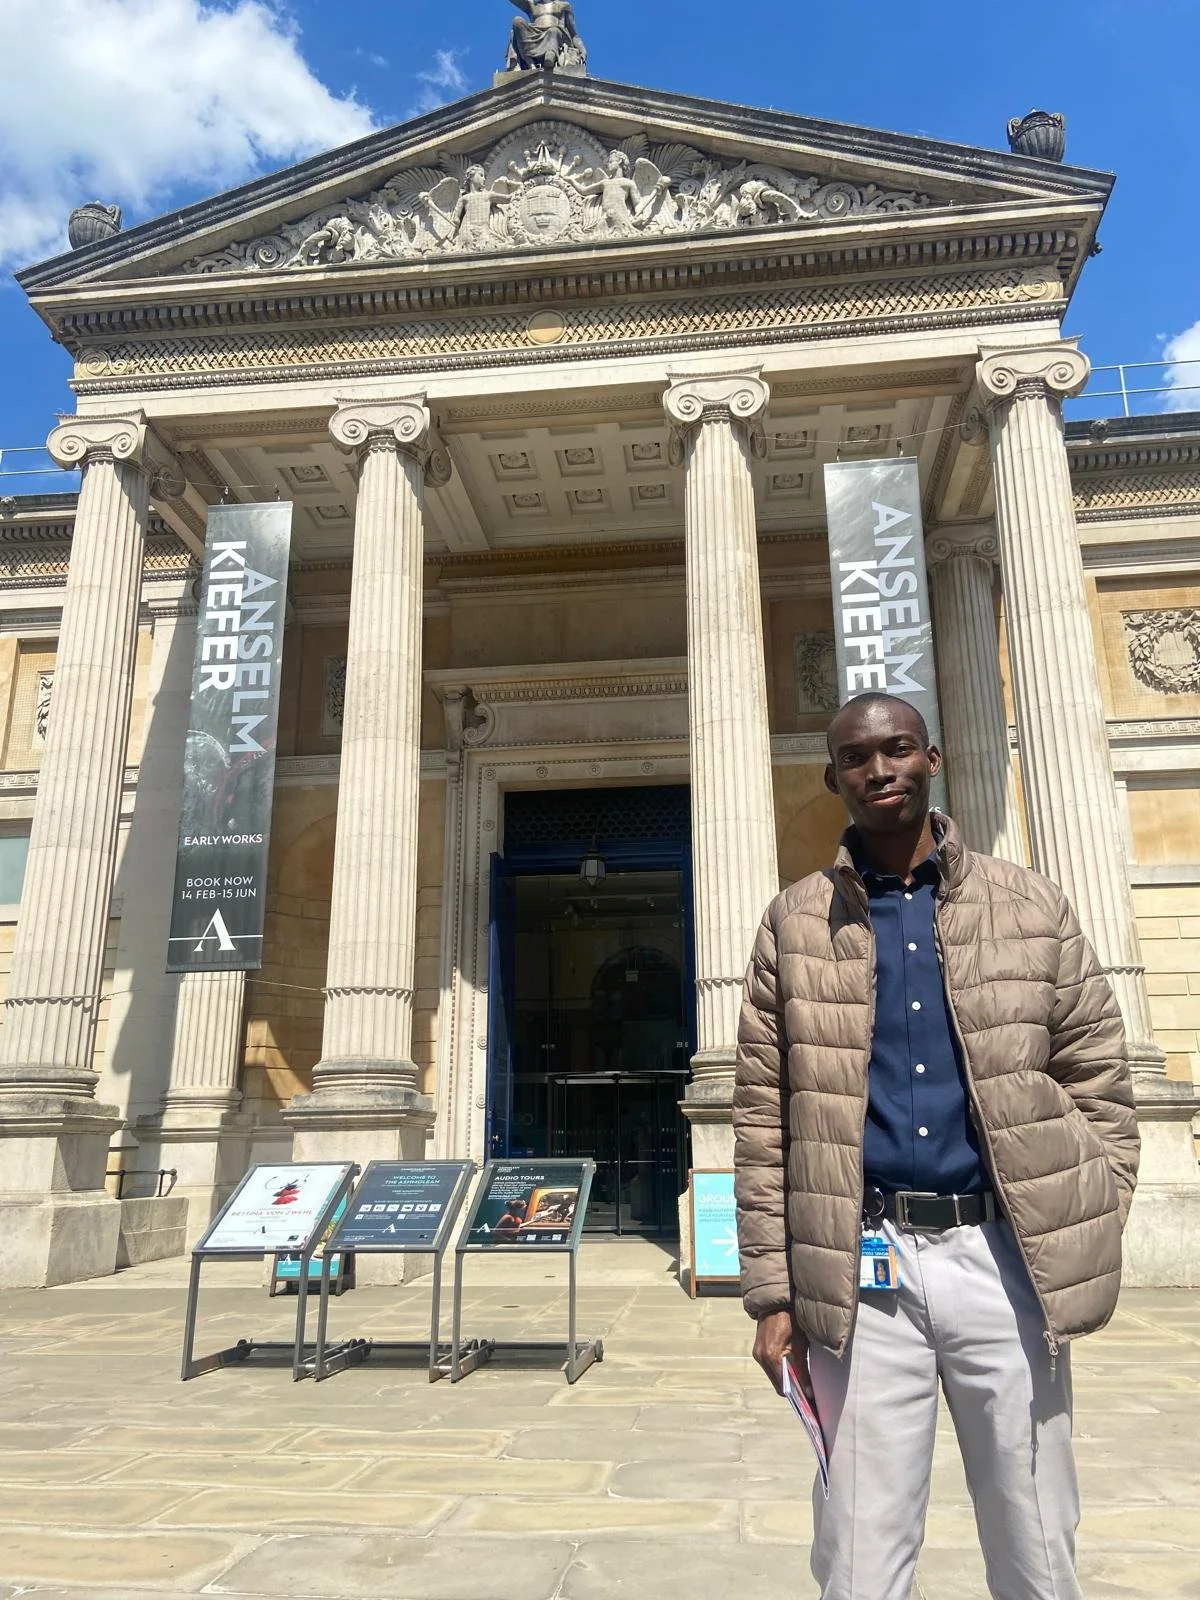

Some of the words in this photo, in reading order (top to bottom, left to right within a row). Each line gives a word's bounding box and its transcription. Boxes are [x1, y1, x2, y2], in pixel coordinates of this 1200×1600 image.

[199, 541, 247, 693] KIEFER
[229, 566, 280, 754] ANSELM
[839, 560, 888, 700] KIEFE
[872, 502, 927, 693] ANSELM
[181, 890, 192, 900] 14
[196, 888, 232, 900] FEB-15
[235, 888, 257, 898] JUN
[184, 836, 219, 846] EARLY
[222, 834, 263, 844] WORKS
[186, 877, 221, 888] BOOK
[224, 876, 254, 886] NOW
